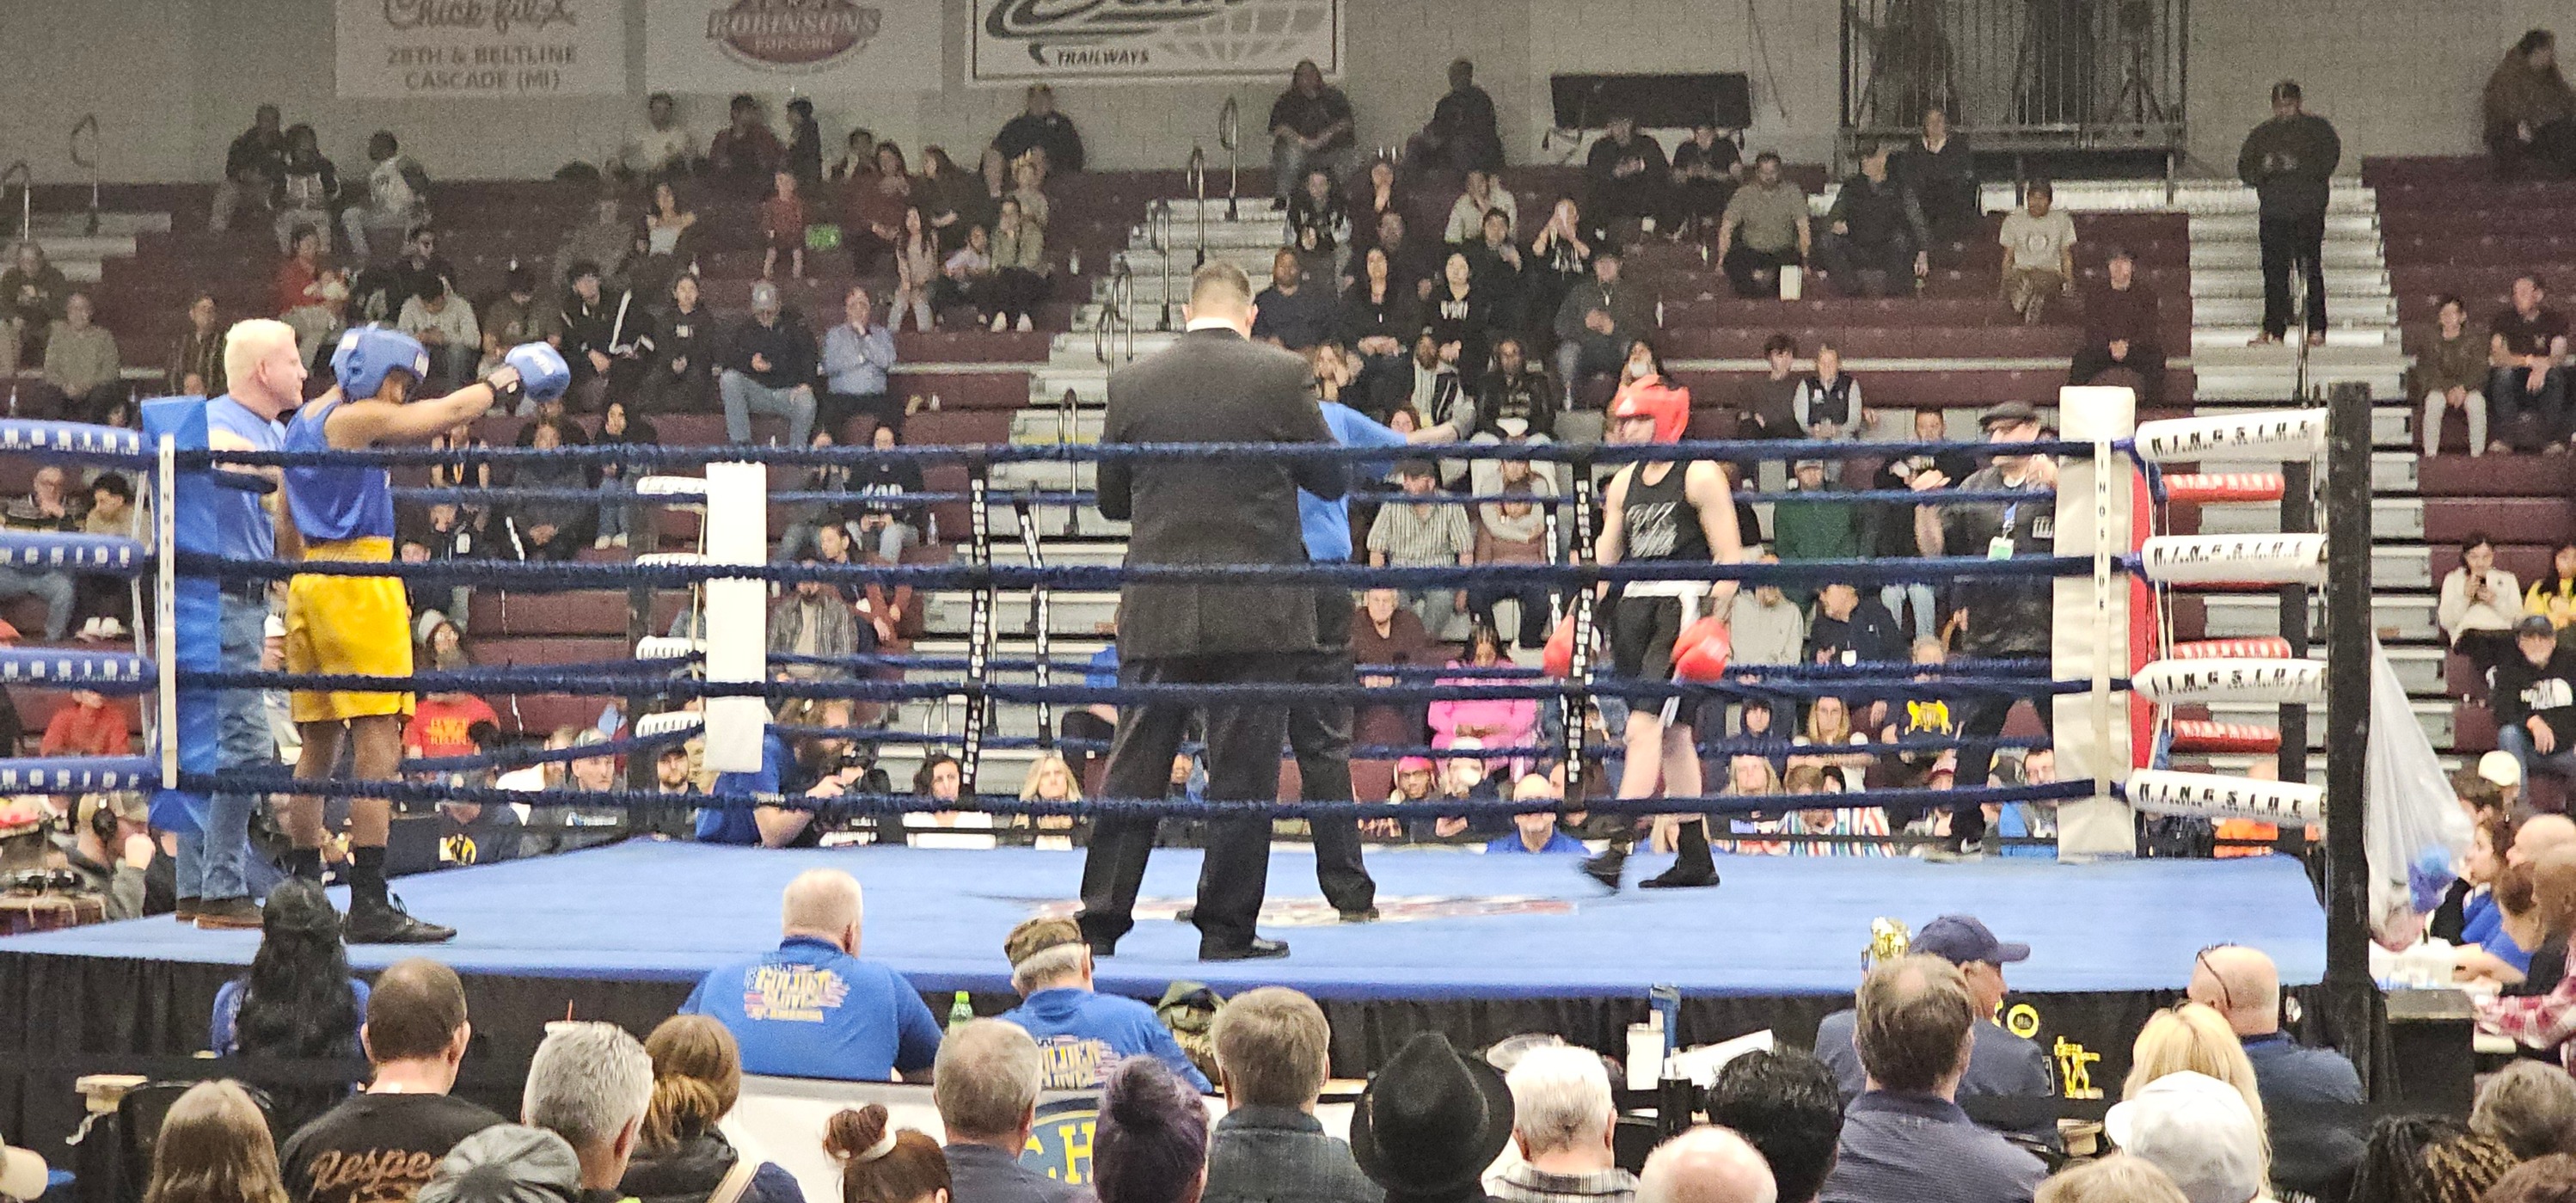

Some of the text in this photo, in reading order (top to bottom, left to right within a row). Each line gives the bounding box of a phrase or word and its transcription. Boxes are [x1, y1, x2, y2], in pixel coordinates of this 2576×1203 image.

[387, 46, 576, 65] 28TH & BELTLINE
[1056, 49, 1150, 66] TRAILWAYS
[404, 70, 506, 90] CASCADE
[306, 1147, 446, 1203] Respec
